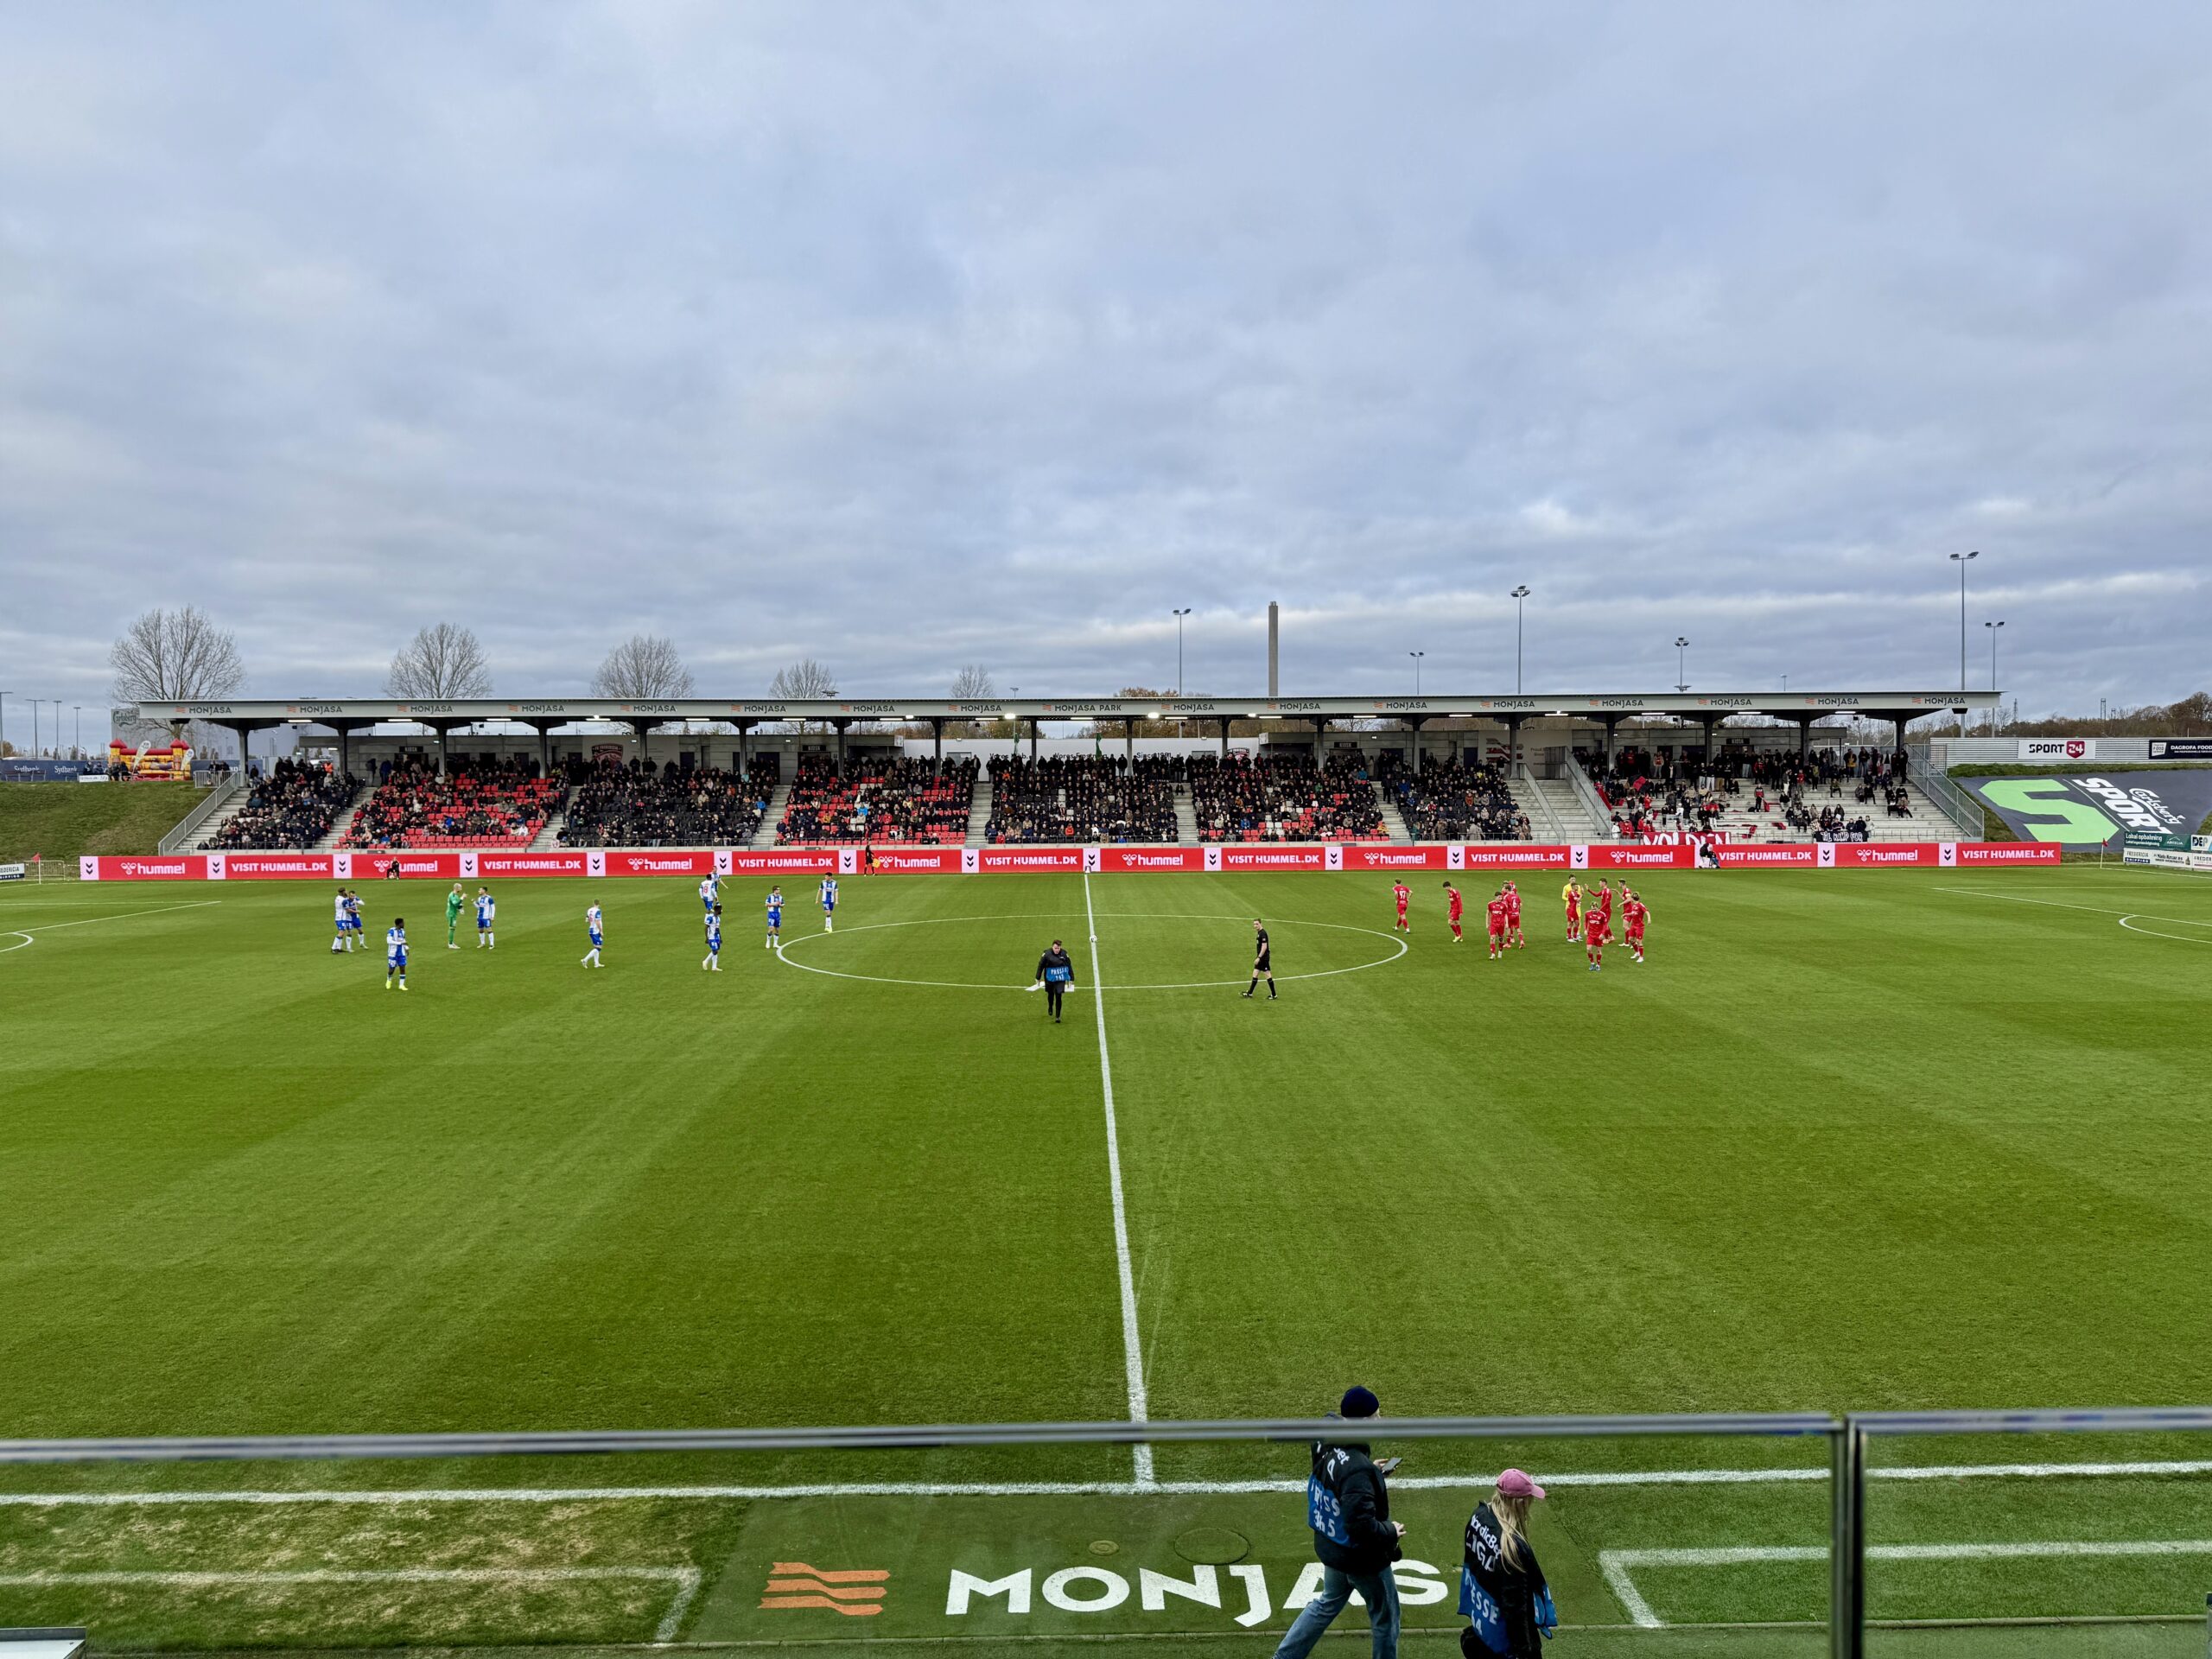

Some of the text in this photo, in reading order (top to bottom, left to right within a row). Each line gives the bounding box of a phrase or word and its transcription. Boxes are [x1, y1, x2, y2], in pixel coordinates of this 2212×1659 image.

[1602, 699, 1643, 708] MONJASA
[1711, 698, 1752, 707] MONJASA
[1818, 697, 1859, 706] MONJASA
[1924, 696, 1966, 705] MONJASA
[189, 707, 232, 715] MONJASA
[300, 706, 343, 715] MONJASA
[410, 705, 454, 714] MONJASA
[633, 704, 677, 713] MONJASA
[744, 704, 786, 713] MONJASA
[854, 704, 894, 713] MONJASA
[1280, 702, 1320, 711] MONJASA
[2029, 743, 2083, 753] SPORT 24
[54, 766, 78, 775] Sydbank
[2129, 788, 2186, 824] Carlsberg
[1228, 854, 1319, 864] VISIT HUMMEL.DK
[1380, 853, 1426, 864] hummel
[1471, 853, 1565, 862] VISIT HUMMEL.DK
[1626, 851, 1674, 863] hummel
[1719, 851, 1812, 861] VISIT HUMMEL.DK
[1872, 849, 1918, 861] hummel
[1962, 849, 2055, 859] VISIT HUMMEL.DK
[645, 858, 693, 870] hummel
[739, 858, 833, 868] VISIT HUMMEL.DK
[894, 855, 941, 868] hummel
[985, 855, 1077, 866] VISIT HUMMEL.DK
[1138, 854, 1184, 866] hummel
[137, 862, 186, 874] hummel
[232, 862, 328, 872] VISIT HUMMEL.DK
[390, 861, 438, 873] ummel
[484, 861, 582, 870] VISIT HUMMEL.DK
